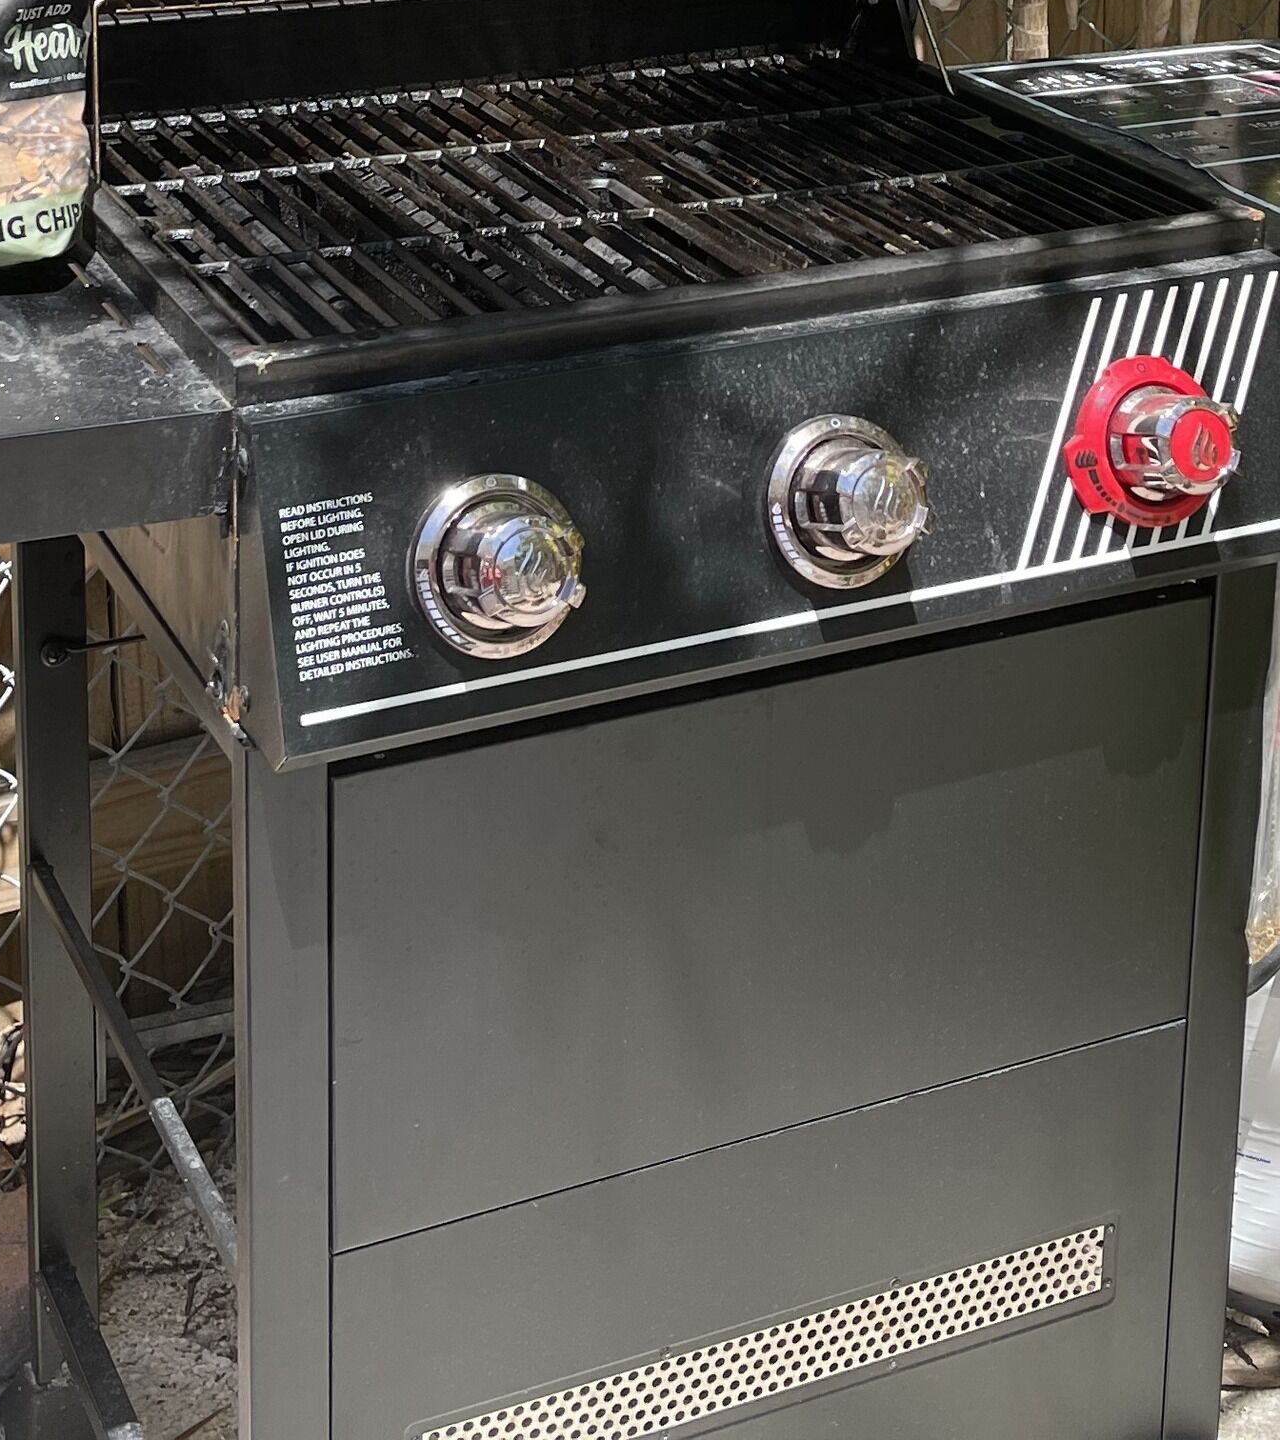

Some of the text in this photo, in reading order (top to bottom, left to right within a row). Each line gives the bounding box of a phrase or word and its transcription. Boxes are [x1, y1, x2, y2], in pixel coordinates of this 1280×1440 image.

[16, 4, 71, 22] JUST ADD
[36, 203, 82, 233] CHIP
[279, 492, 373, 519] READ INSTRUCTIONS
[280, 508, 364, 533] BEFORE LIGHTING.
[282, 521, 364, 546] OPEN LID DURING
[284, 542, 331, 560] LIGHTING.
[285, 548, 365, 573] IF IGNITION DOES
[287, 563, 362, 587] NOT OCCUR IN 5
[289, 572, 381, 600] SECONDS, TURN THE
[290, 586, 385, 613] BURNER CONTROL(S)
[292, 599, 390, 627] OFF, WAIT 5 MINUTES,
[294, 616, 371, 641] AND REPEAT THE
[295, 623, 404, 655] LIGHTING PROCEDURES.
[297, 637, 402, 668] SEE USER MANUAL FOR
[299, 648, 415, 682] DETAILED INSTRUCTIONS.
